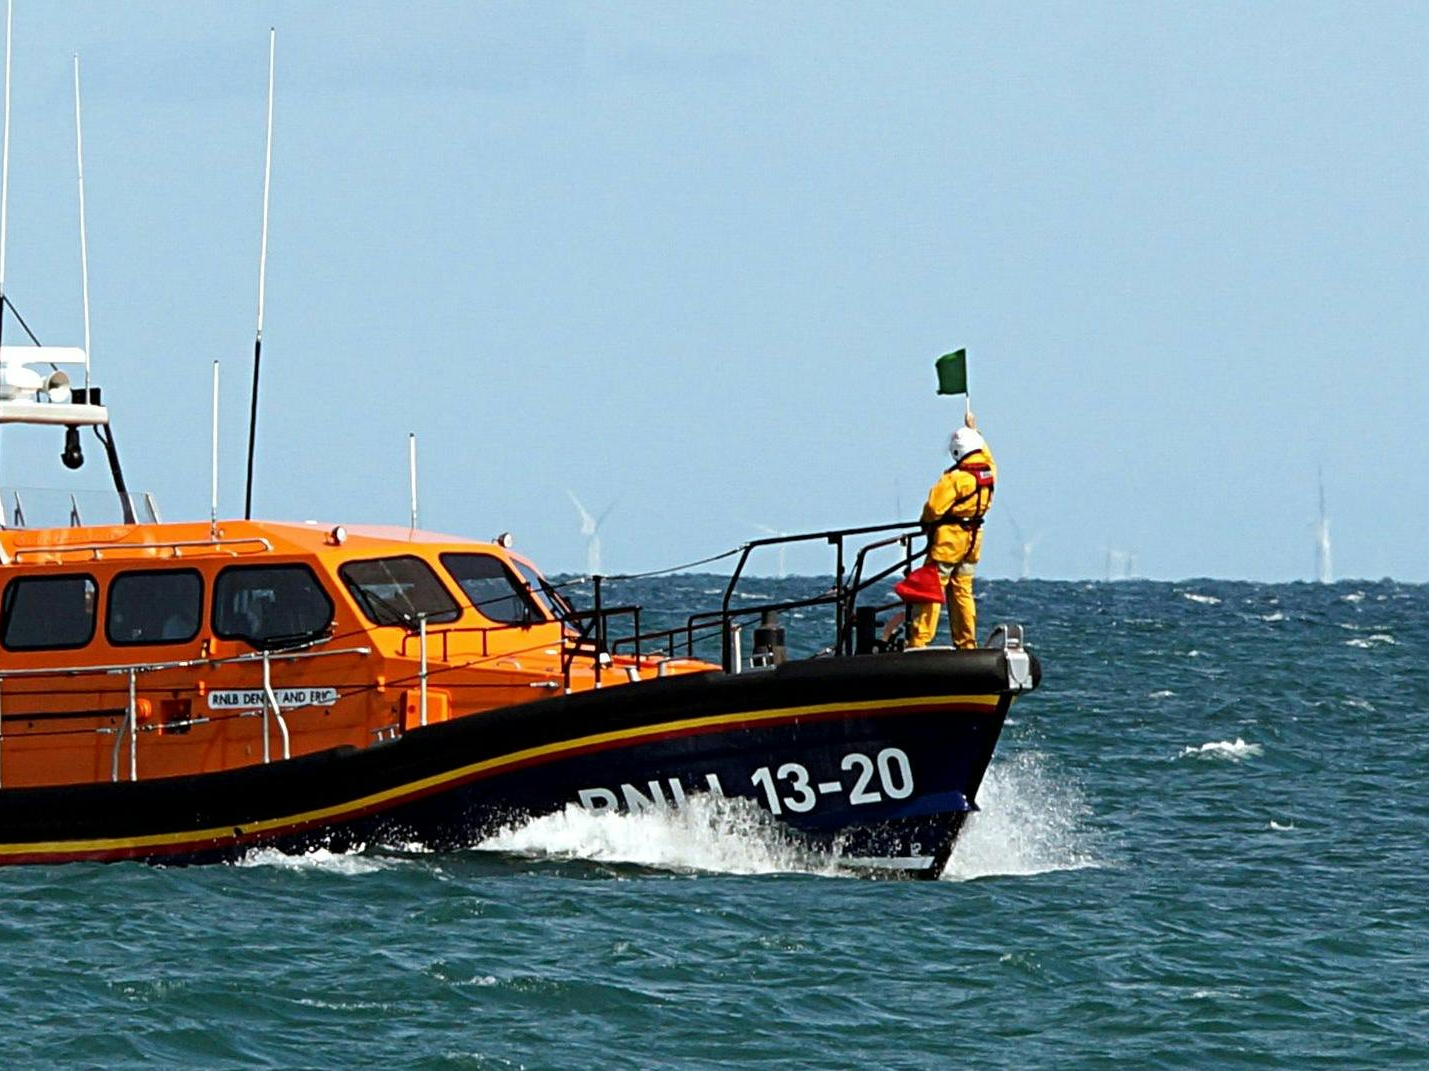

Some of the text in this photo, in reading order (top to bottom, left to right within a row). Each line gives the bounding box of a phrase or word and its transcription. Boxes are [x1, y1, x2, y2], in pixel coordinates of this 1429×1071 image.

[212, 693, 239, 705] RNLB
[243, 691, 279, 705] DENE
[283, 691, 306, 704] AND
[750, 747, 915, 816] 13-20
